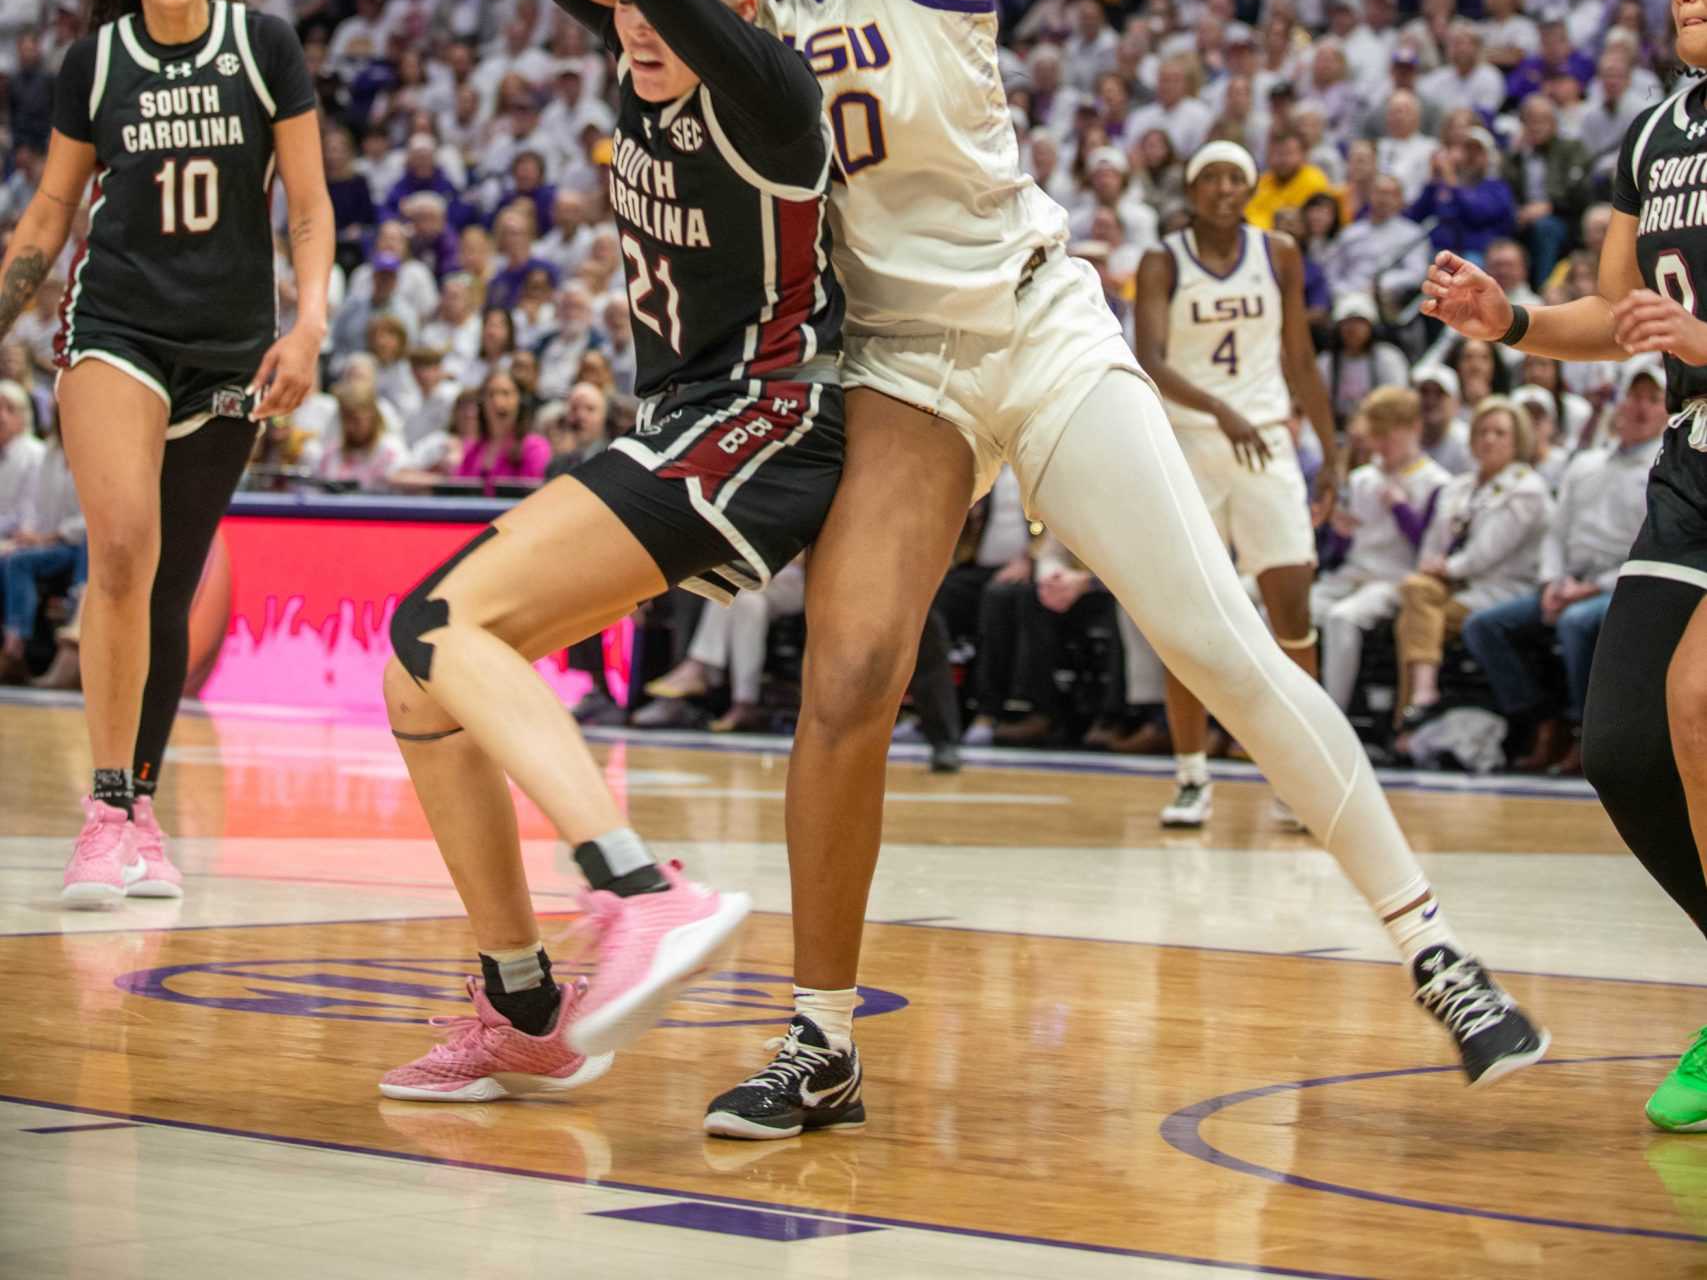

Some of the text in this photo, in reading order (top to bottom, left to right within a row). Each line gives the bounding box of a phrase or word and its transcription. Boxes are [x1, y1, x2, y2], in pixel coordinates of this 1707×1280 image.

[138, 84, 221, 118] SOUTH
[121, 115, 246, 154] CAROLINA
[611, 127, 677, 199] SOUTH
[670, 117, 704, 152] SEC
[830, 90, 888, 187] 0
[154, 156, 220, 236] 10
[609, 169, 712, 248] AROLINA
[620, 232, 683, 357] 21
[1191, 295, 1264, 324] LSU
[1211, 328, 1239, 377] 4
